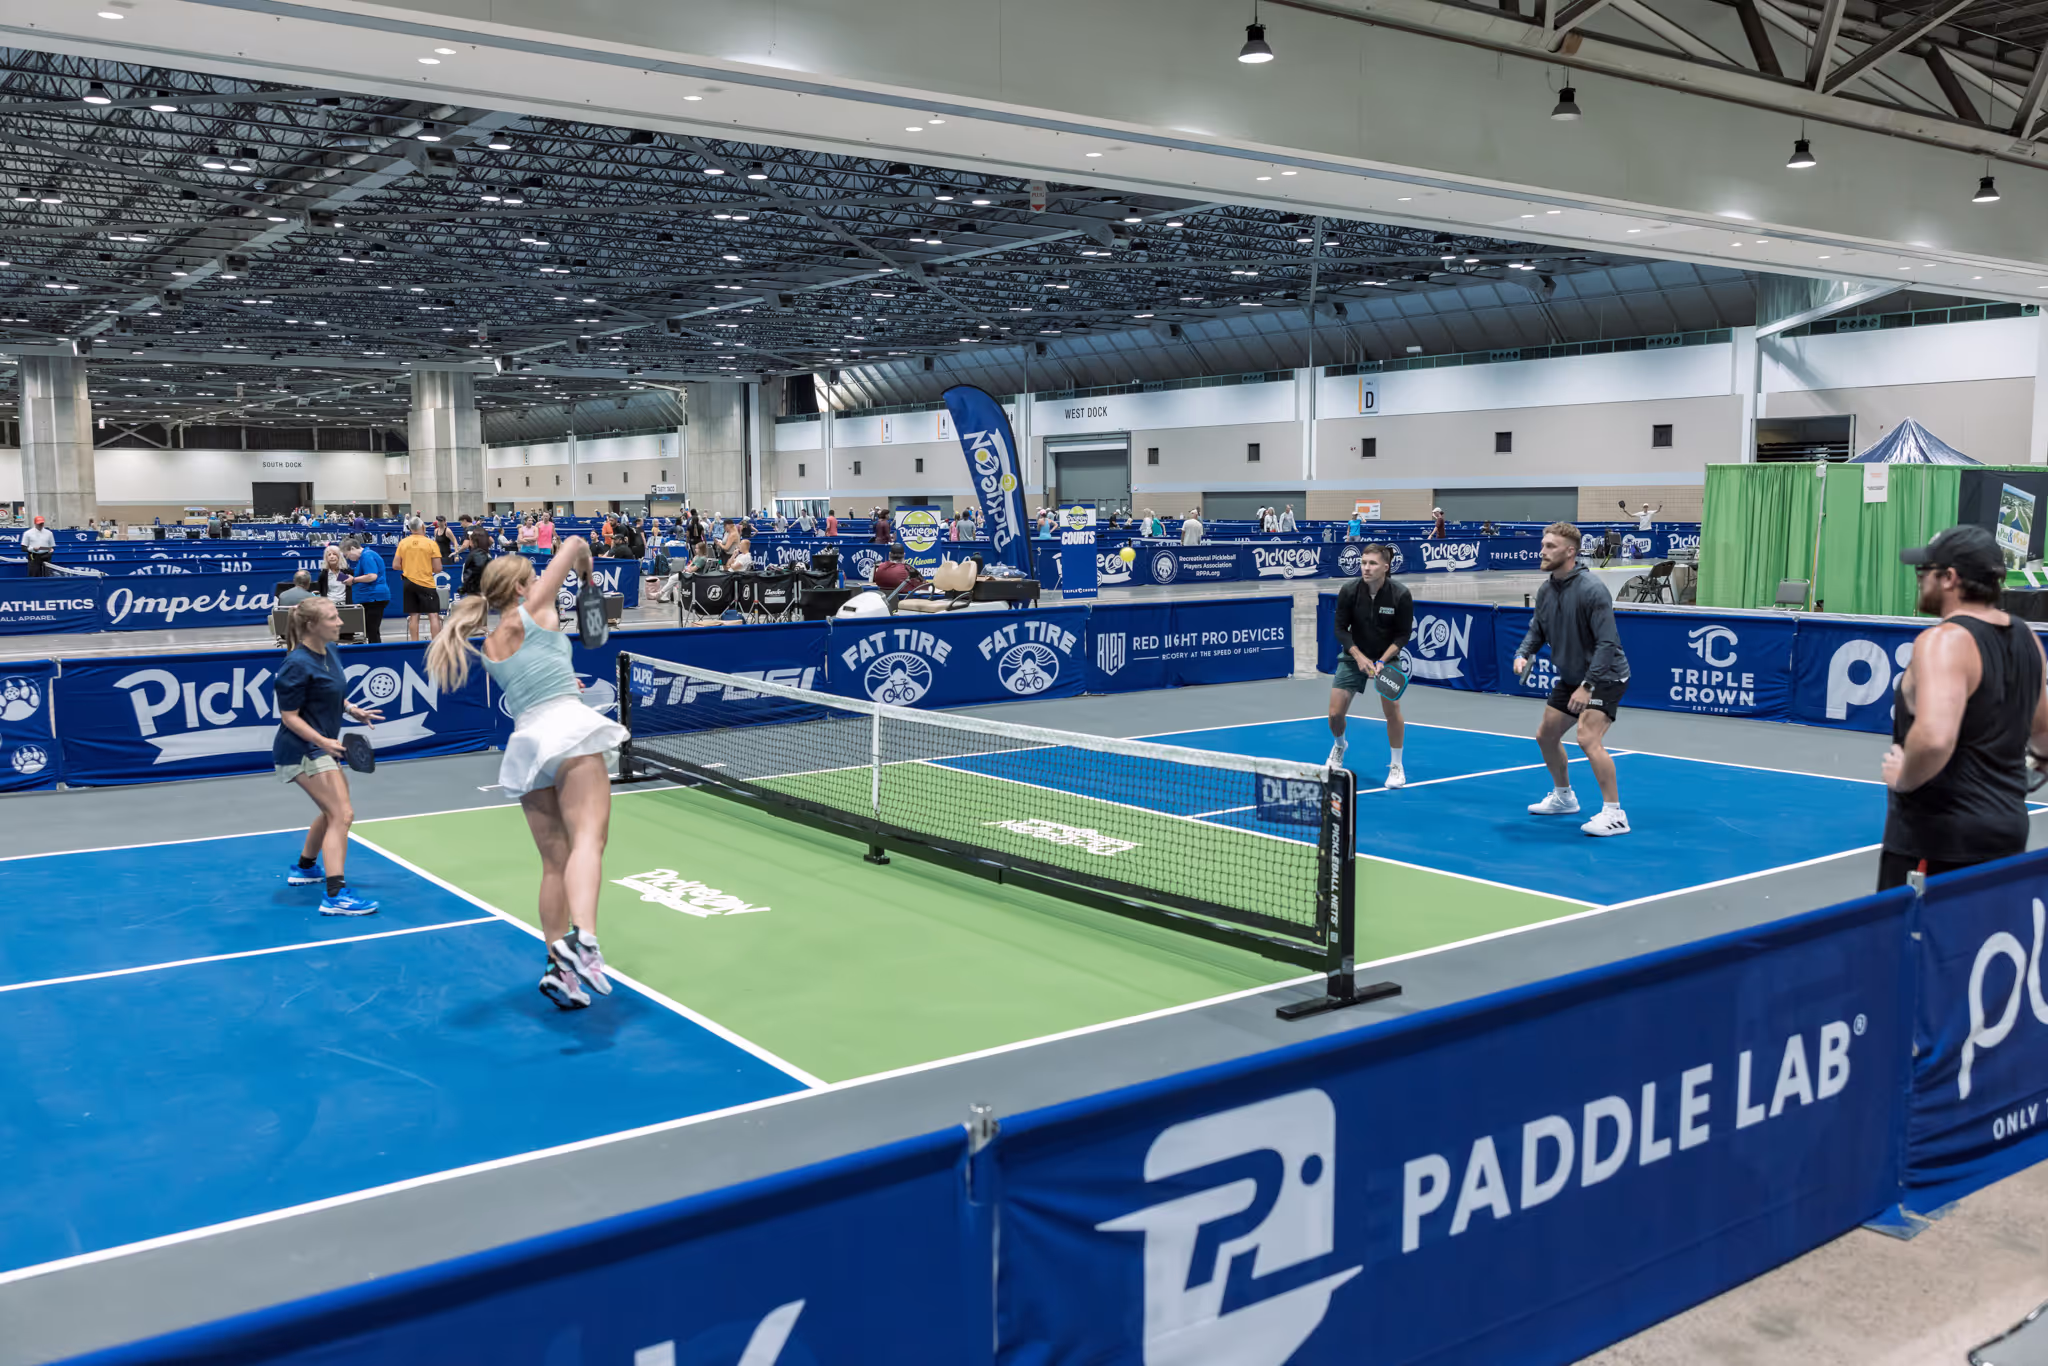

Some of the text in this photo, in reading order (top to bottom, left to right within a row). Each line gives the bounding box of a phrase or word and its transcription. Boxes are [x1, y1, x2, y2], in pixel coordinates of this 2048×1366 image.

[1365, 391, 1374, 409] D
[1064, 406, 1108, 420] WEST DOCK
[1061, 531, 1096, 545] COURTS
[1490, 552, 1518, 560] TRIPLE
[18, 615, 57, 623] APPAREL
[978, 620, 1077, 661] FAT TIRE
[1133, 635, 1159, 651] RED
[1202, 631, 1228, 646] PRO
[1232, 626, 1285, 643] DEVICES
[841, 628, 952, 672] FAT TIRE
[1213, 648, 1232, 656] SPEED
[1243, 646, 1260, 654] LIGHT
[633, 666, 654, 686] DUPR
[1379, 674, 1401, 694] DIADEM
[1671, 668, 1755, 688] TRIPLE
[1669, 685, 1757, 706] CROWN
[1262, 777, 1322, 808] DUPR
[1331, 822, 1341, 891] PICKLEBALL
[1330, 893, 1339, 928] NETS
[1992, 1102, 2040, 1141] ONLY
[1402, 1063, 1713, 1254] PADDLE
